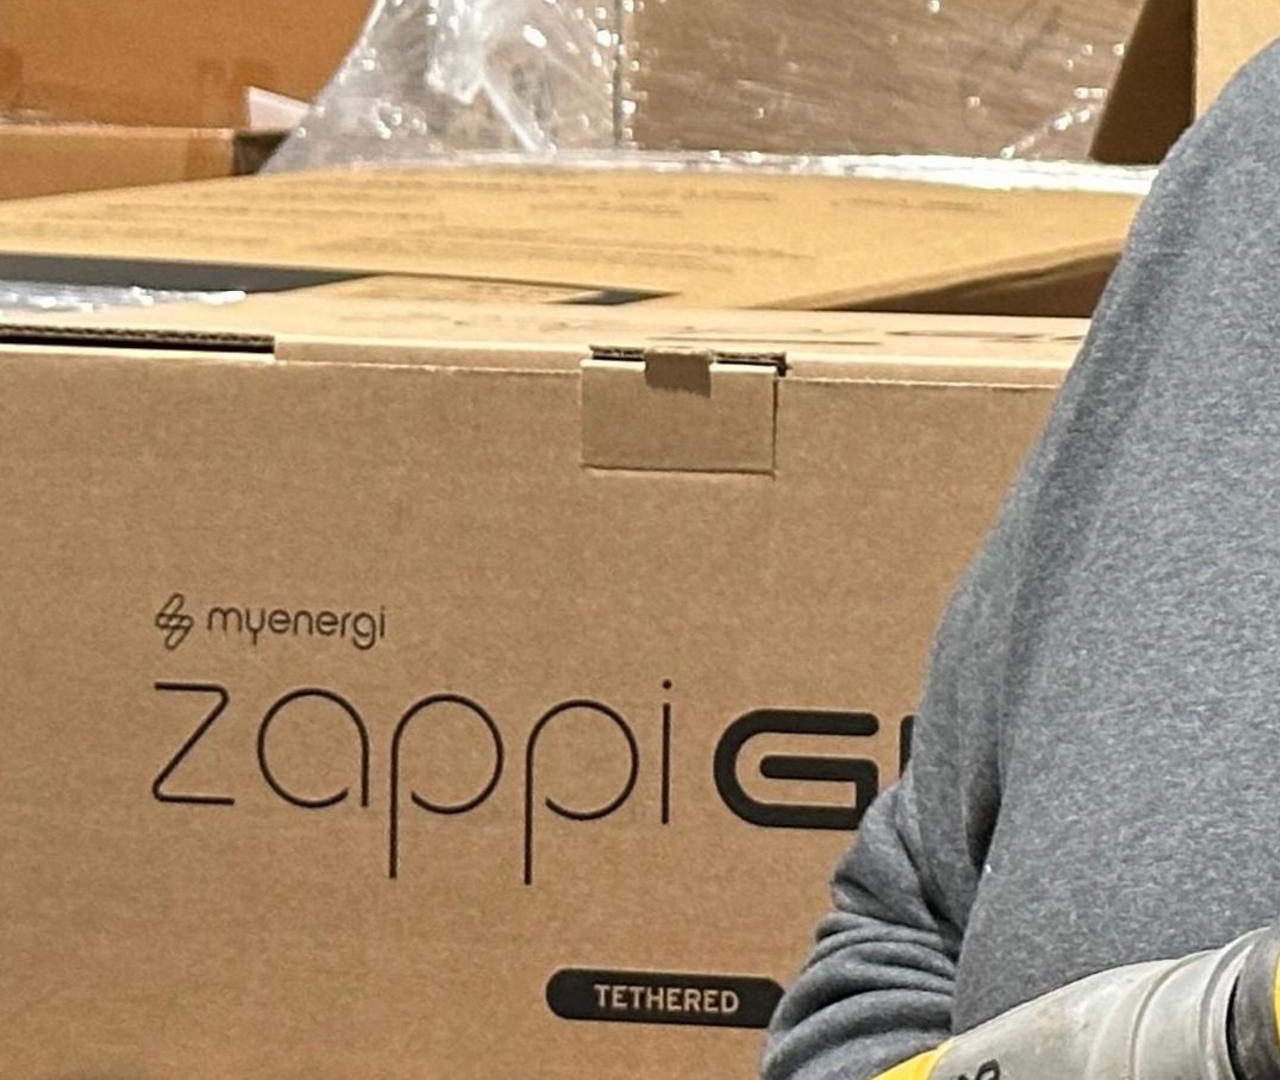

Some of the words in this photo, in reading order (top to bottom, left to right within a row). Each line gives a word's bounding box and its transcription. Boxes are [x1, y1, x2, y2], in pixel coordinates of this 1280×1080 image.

[206, 605, 386, 650] myenergi
[152, 679, 672, 886] zappi
[593, 983, 740, 1014] TETHERED
